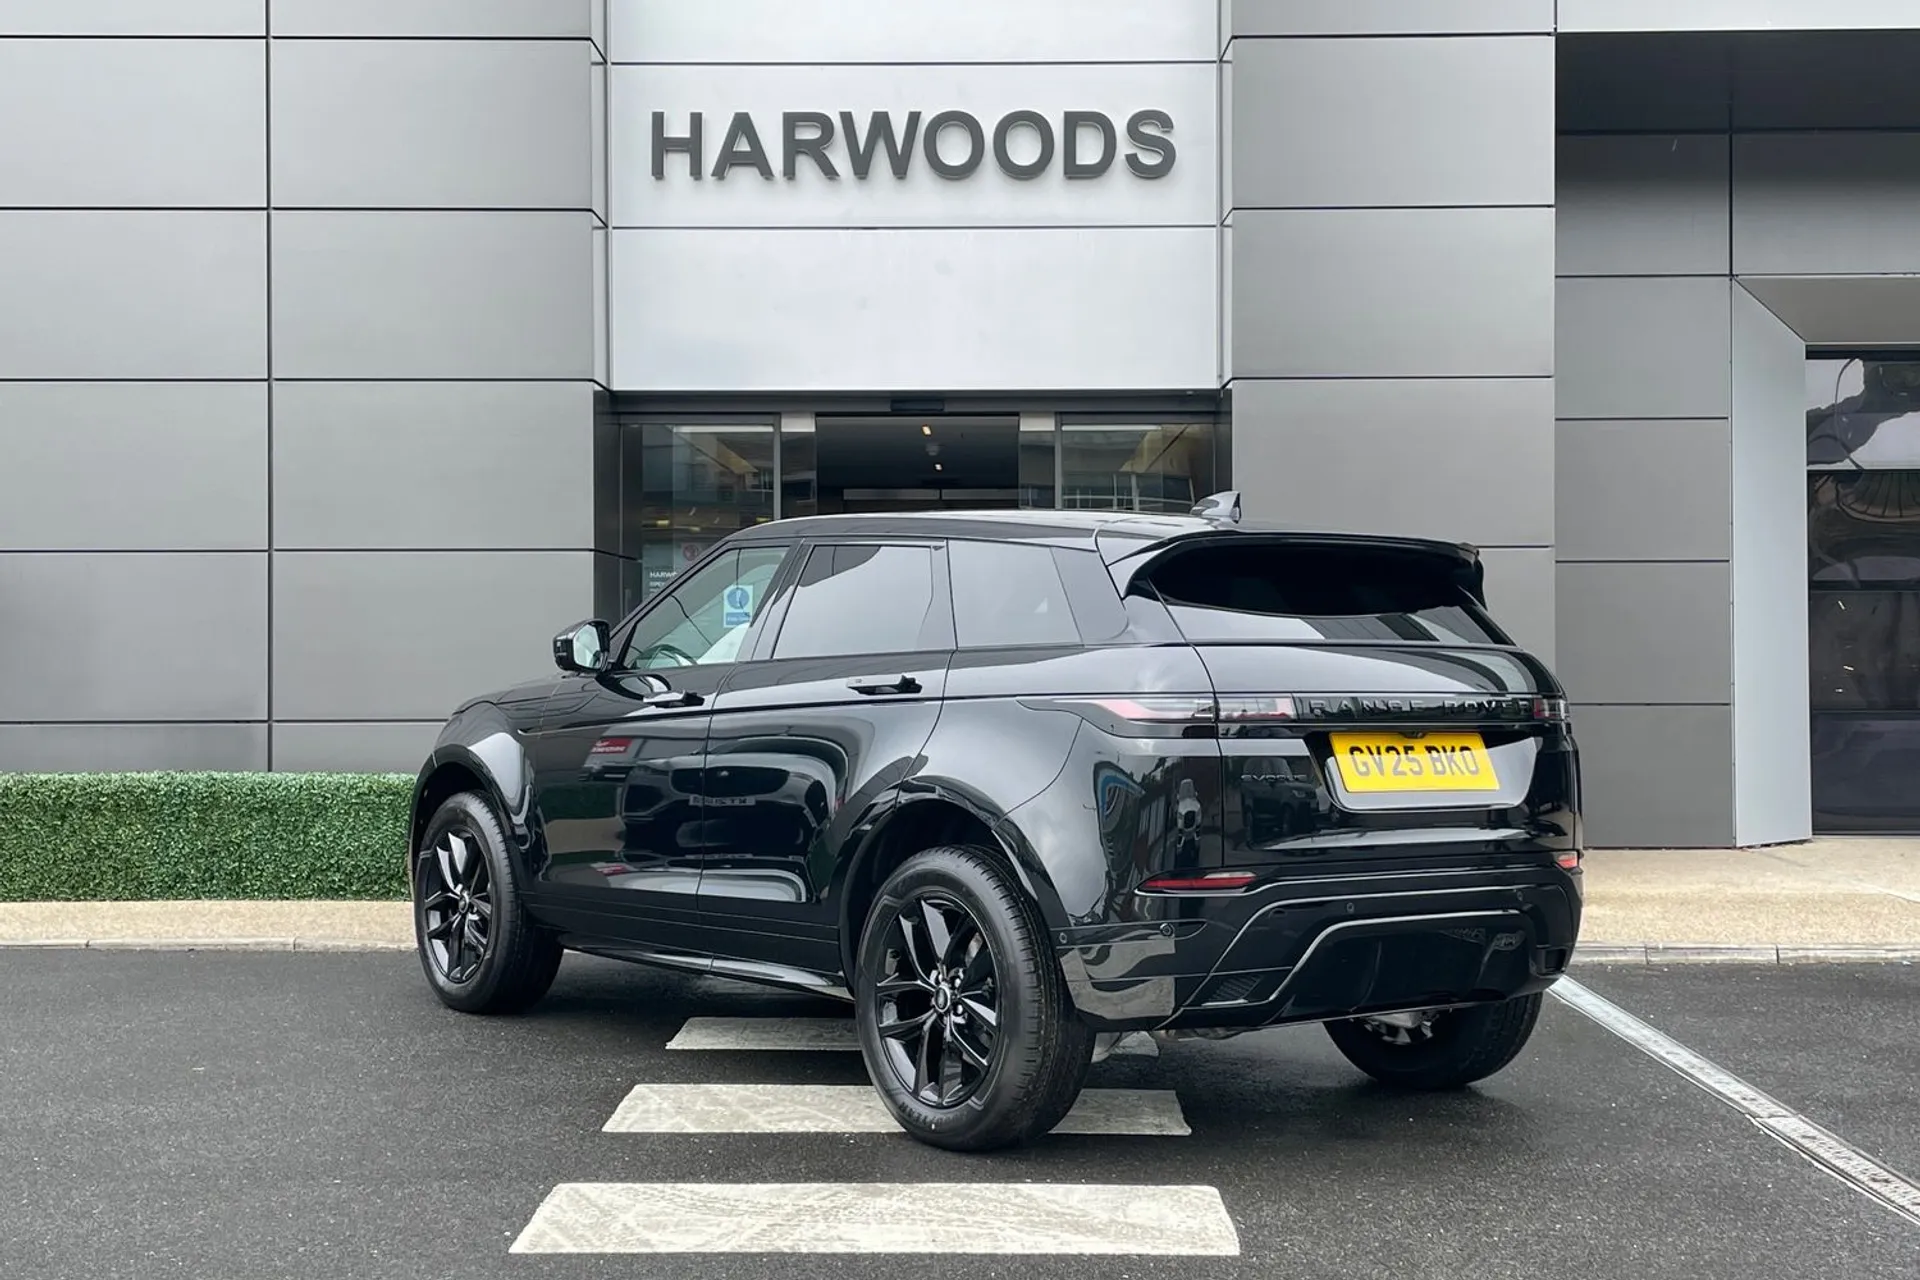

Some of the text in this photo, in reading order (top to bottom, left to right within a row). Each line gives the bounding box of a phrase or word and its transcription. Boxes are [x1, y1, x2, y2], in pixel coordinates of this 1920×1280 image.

[651, 109, 1177, 180] HARWOODS
[1308, 697, 1532, 718] RANGE ROVER
[1348, 744, 1480, 777] GV25 BKO
